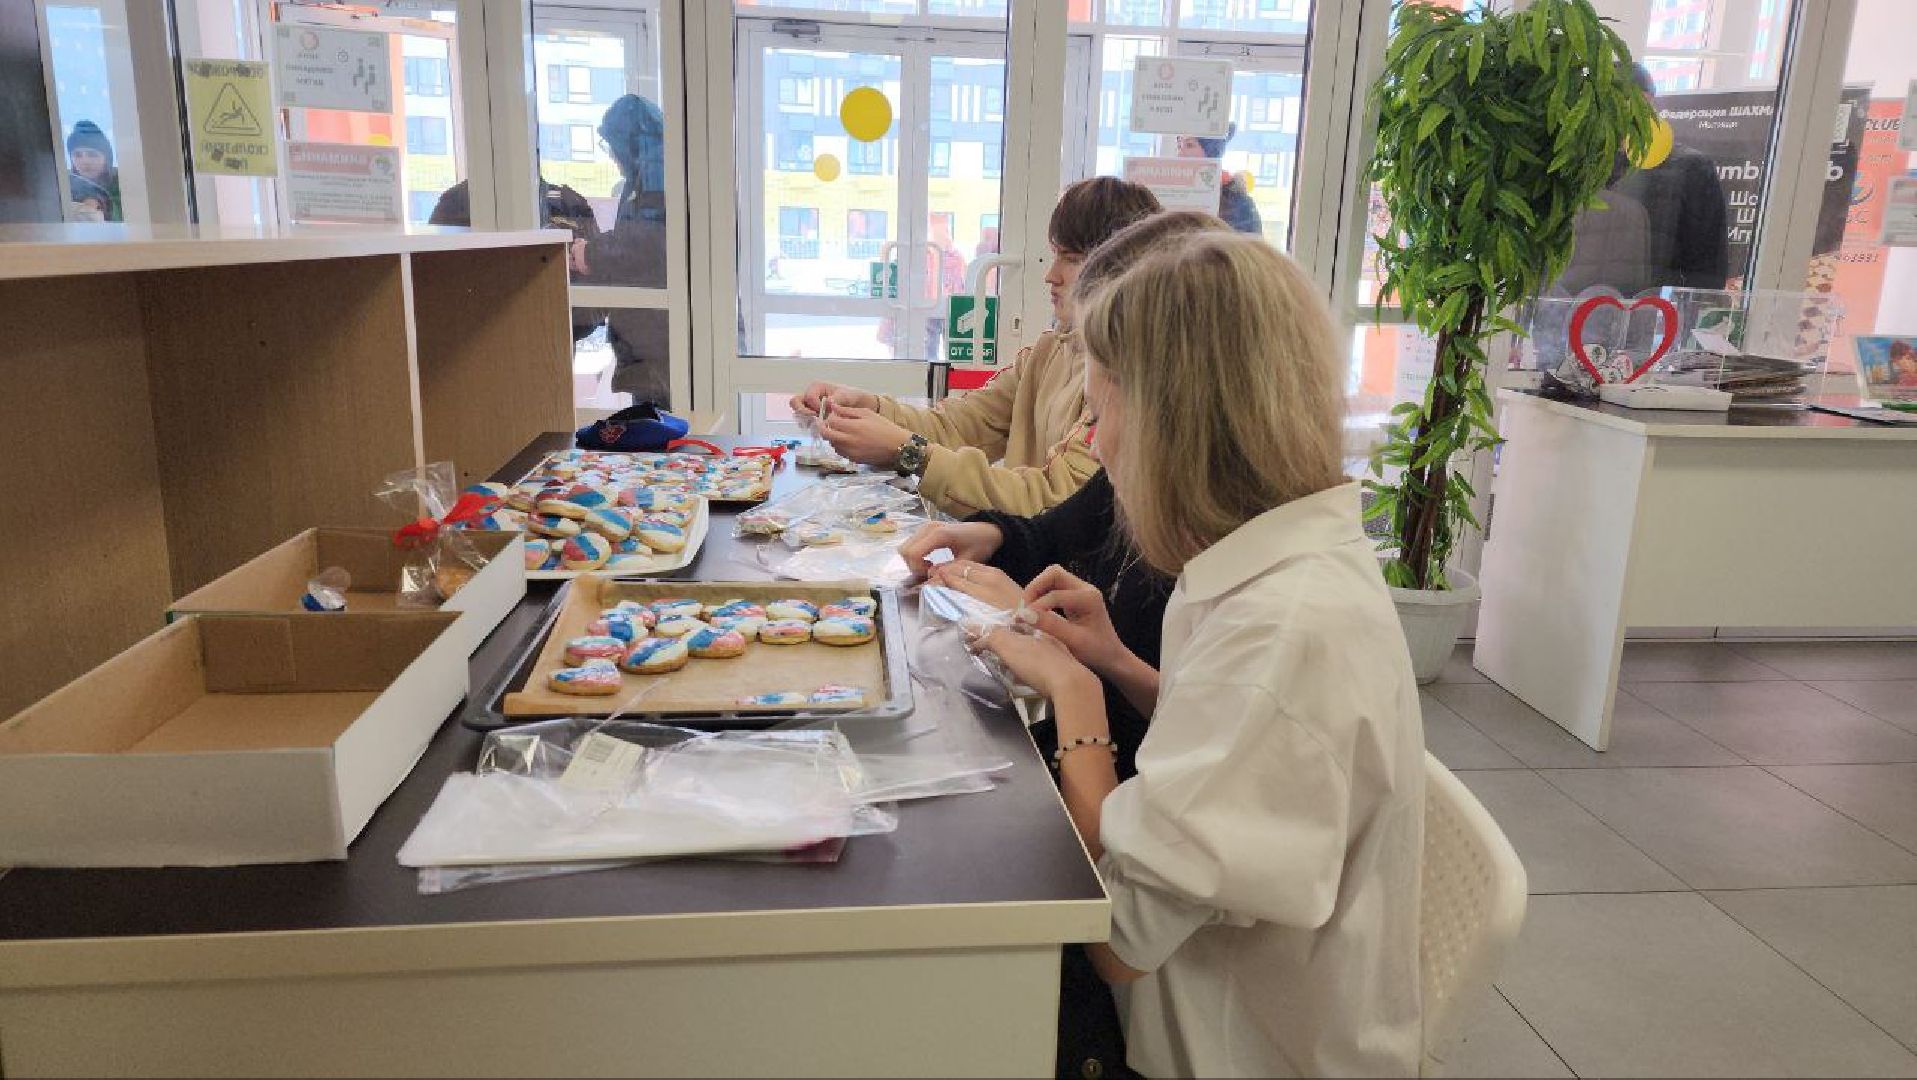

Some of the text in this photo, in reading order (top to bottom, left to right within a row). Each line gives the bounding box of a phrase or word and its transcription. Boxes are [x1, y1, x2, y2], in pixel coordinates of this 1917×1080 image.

[1729, 105, 1774, 117] ШАХМ
[1728, 226, 1753, 244] Игр
[950, 346, 993, 357] ОТ СЯ
